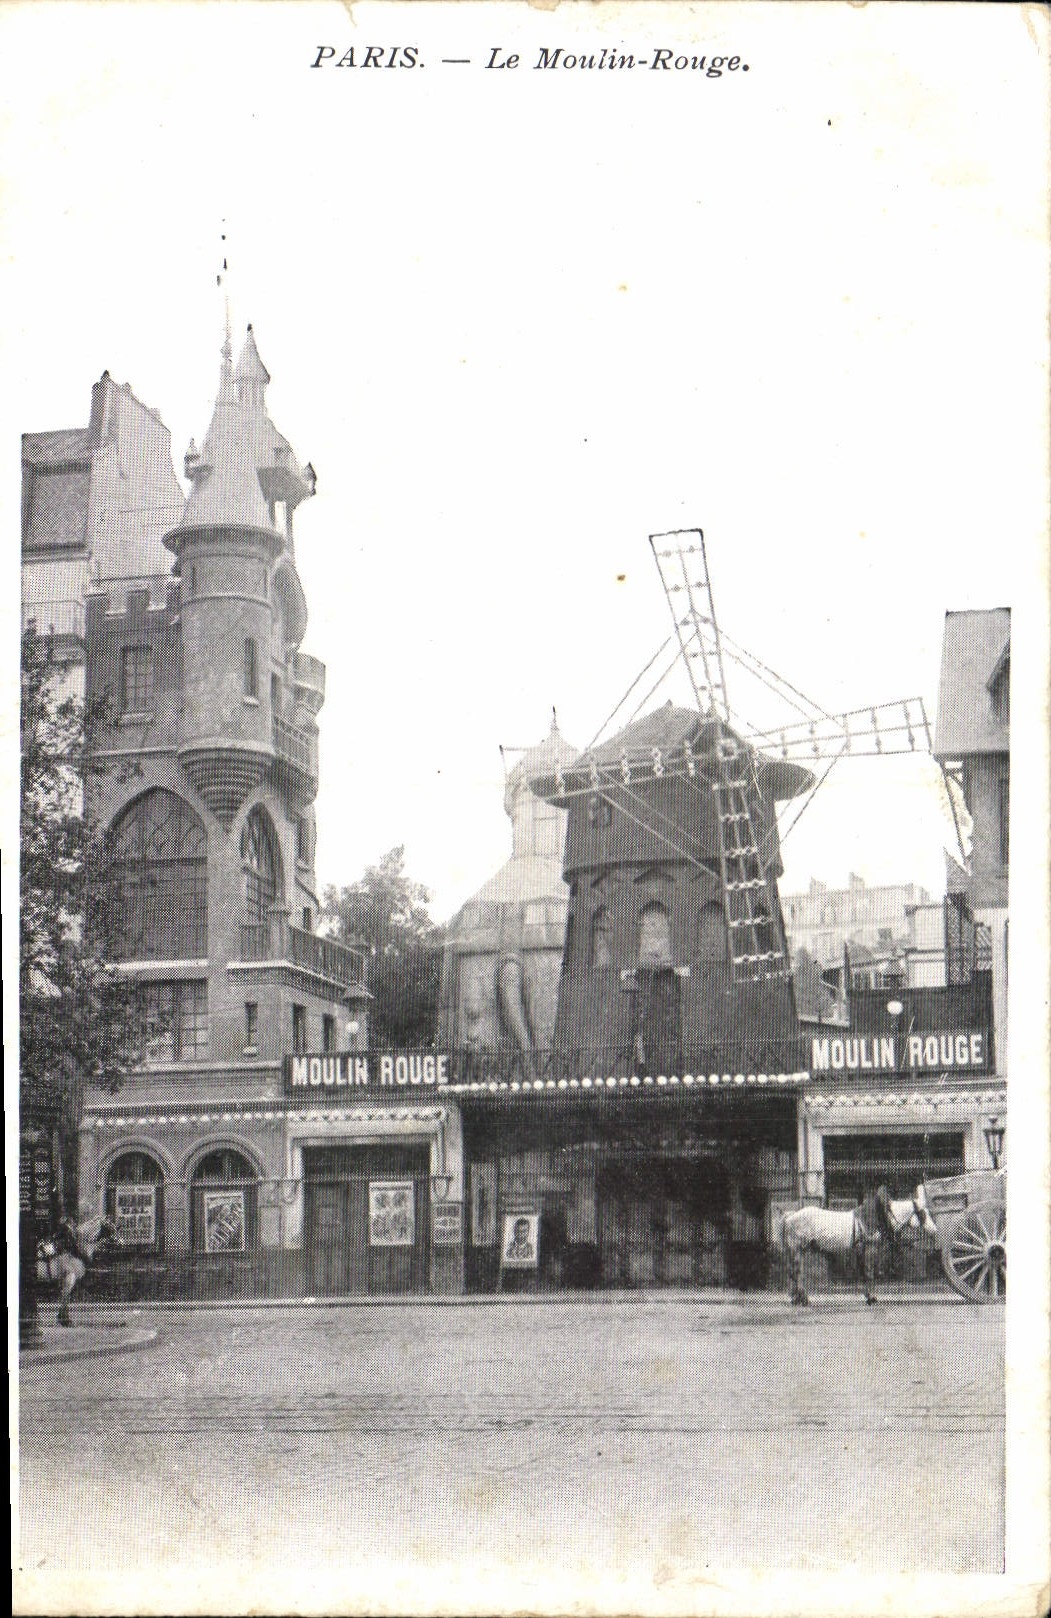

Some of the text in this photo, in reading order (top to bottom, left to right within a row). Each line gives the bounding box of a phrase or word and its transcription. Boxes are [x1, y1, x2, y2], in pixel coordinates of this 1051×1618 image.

[811, 1034, 984, 1070] MOULIN ROUGE
[291, 1054, 449, 1086] MOULIN ROUGE
